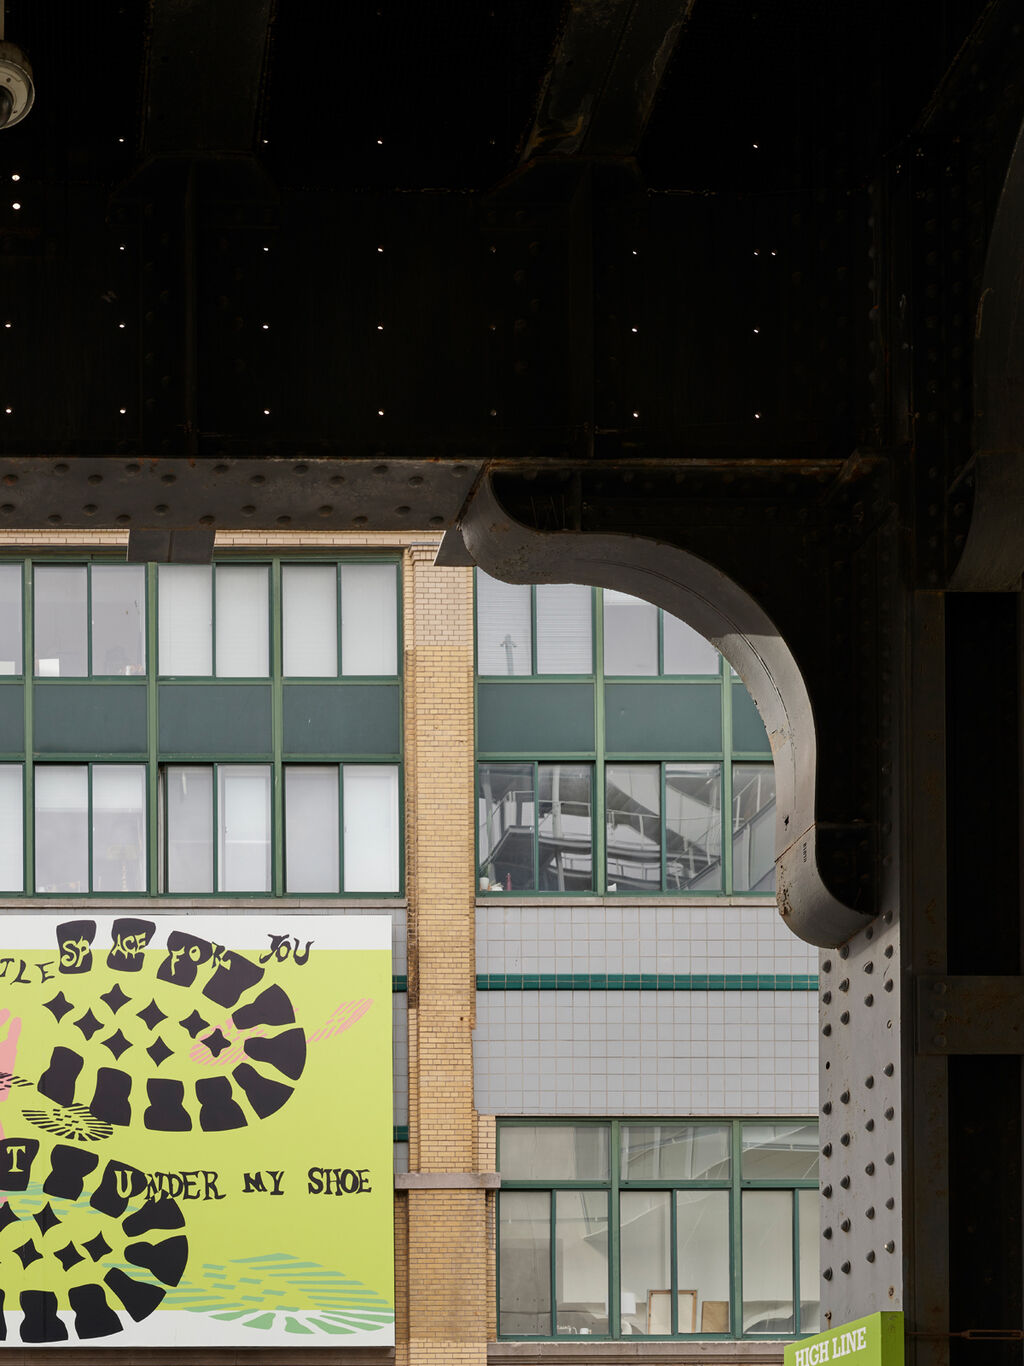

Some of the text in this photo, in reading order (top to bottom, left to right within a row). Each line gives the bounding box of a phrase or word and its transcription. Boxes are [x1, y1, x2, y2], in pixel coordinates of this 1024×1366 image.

[60, 931, 147, 968] SPACE
[170, 940, 232, 977] FOR
[259, 933, 315, 966] YOU
[114, 1170, 227, 1203] UNDER
[242, 1169, 285, 1196] MY
[308, 1166, 373, 1196] SHOE
[831, 1326, 867, 1360] LINE
